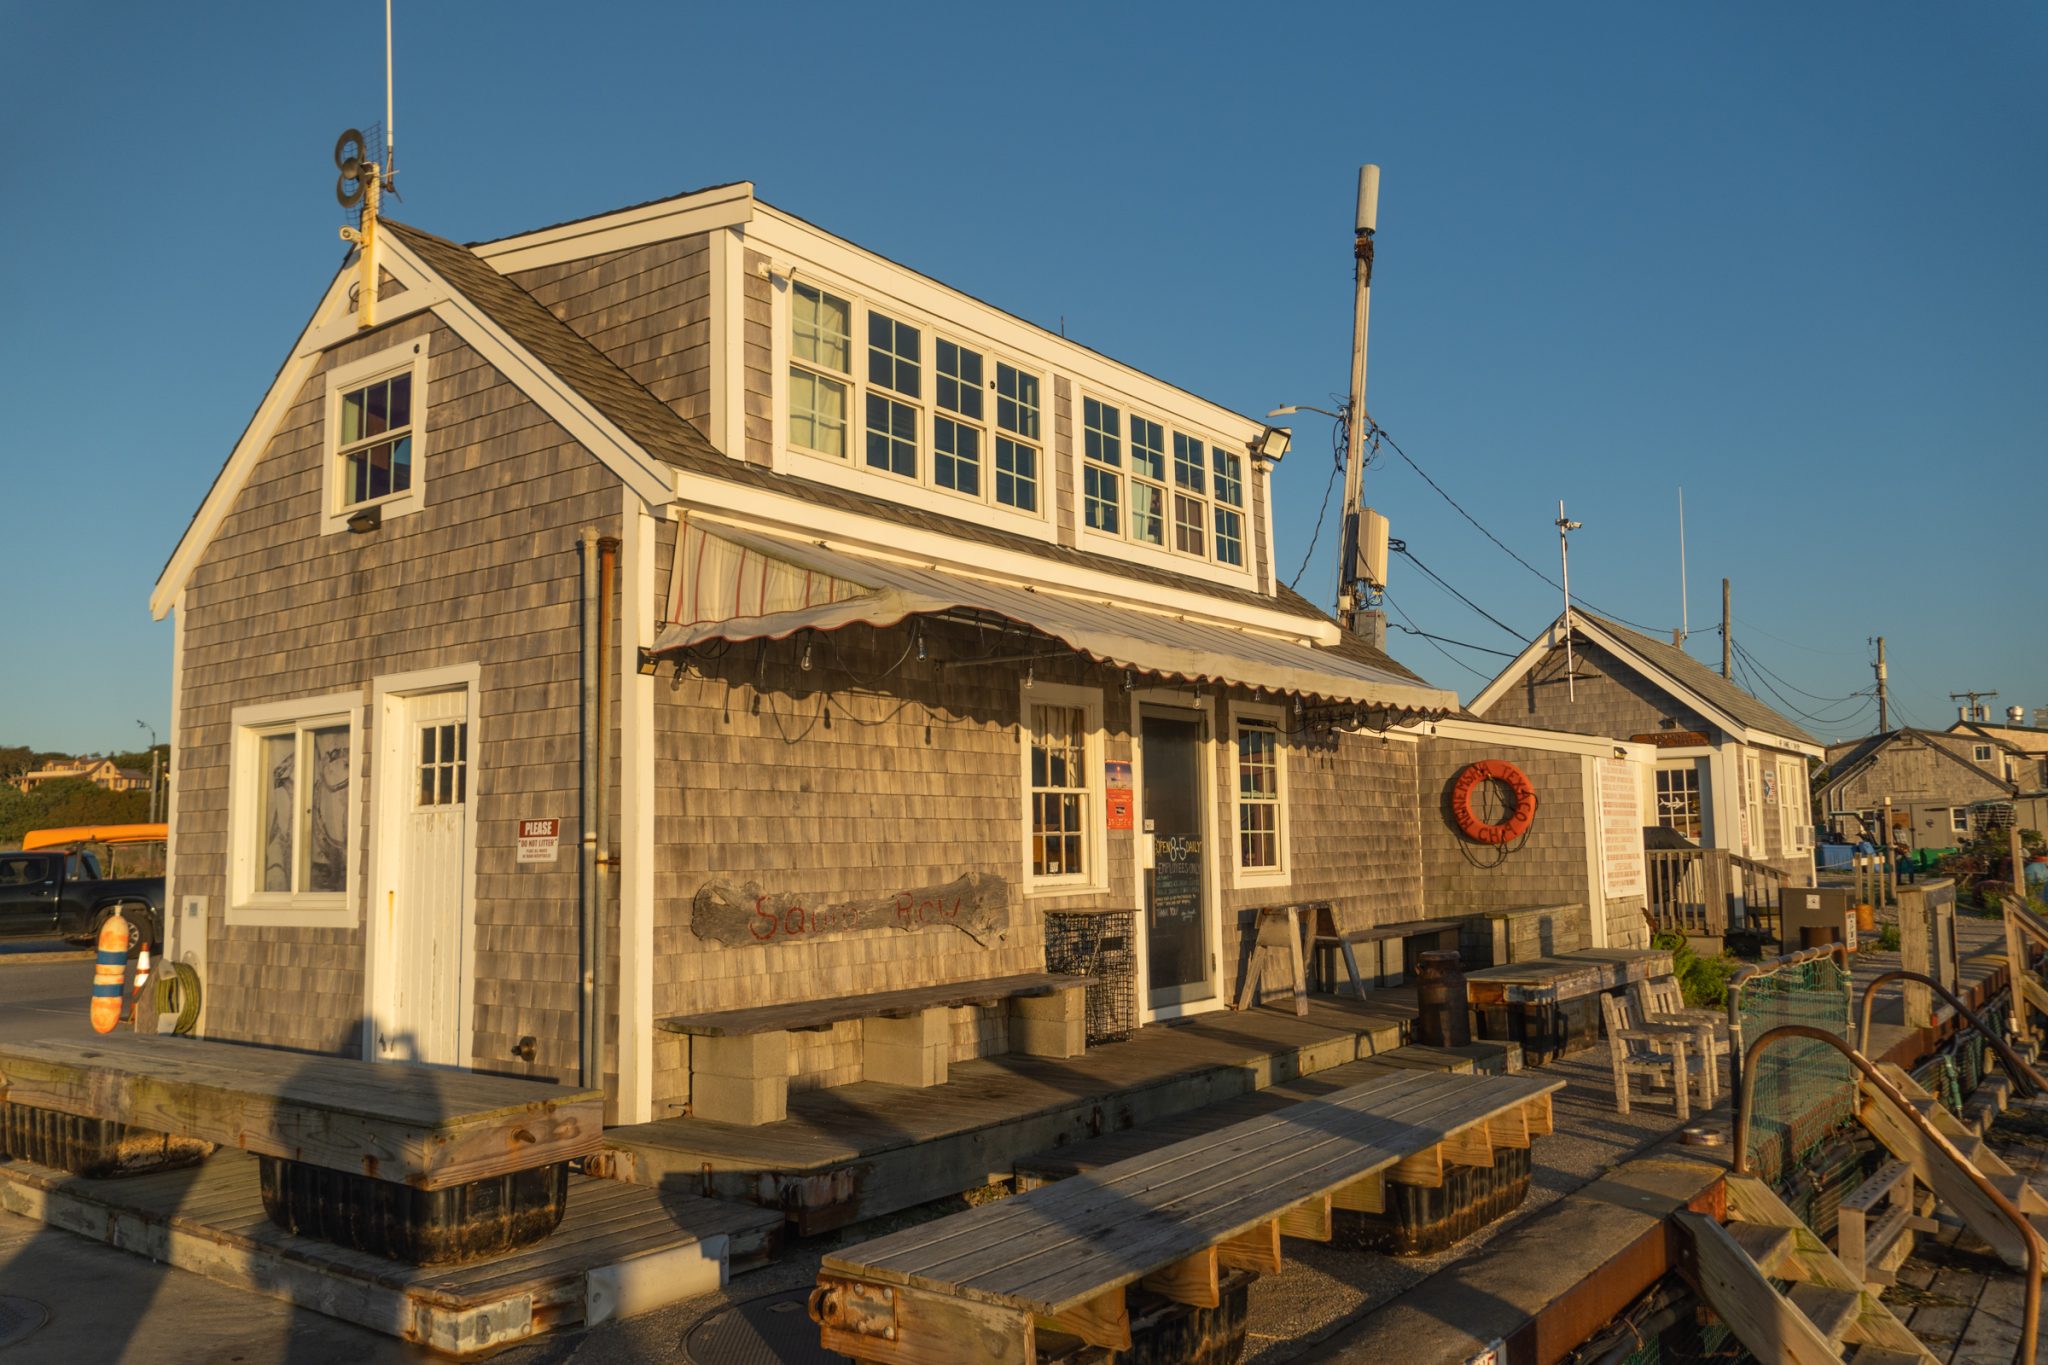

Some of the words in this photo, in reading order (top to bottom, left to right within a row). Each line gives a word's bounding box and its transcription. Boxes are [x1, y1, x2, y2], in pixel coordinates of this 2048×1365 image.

[1503, 766, 1531, 822] TEXACO
[525, 821, 552, 836] PLEASE
[529, 839, 538, 848] NOT
